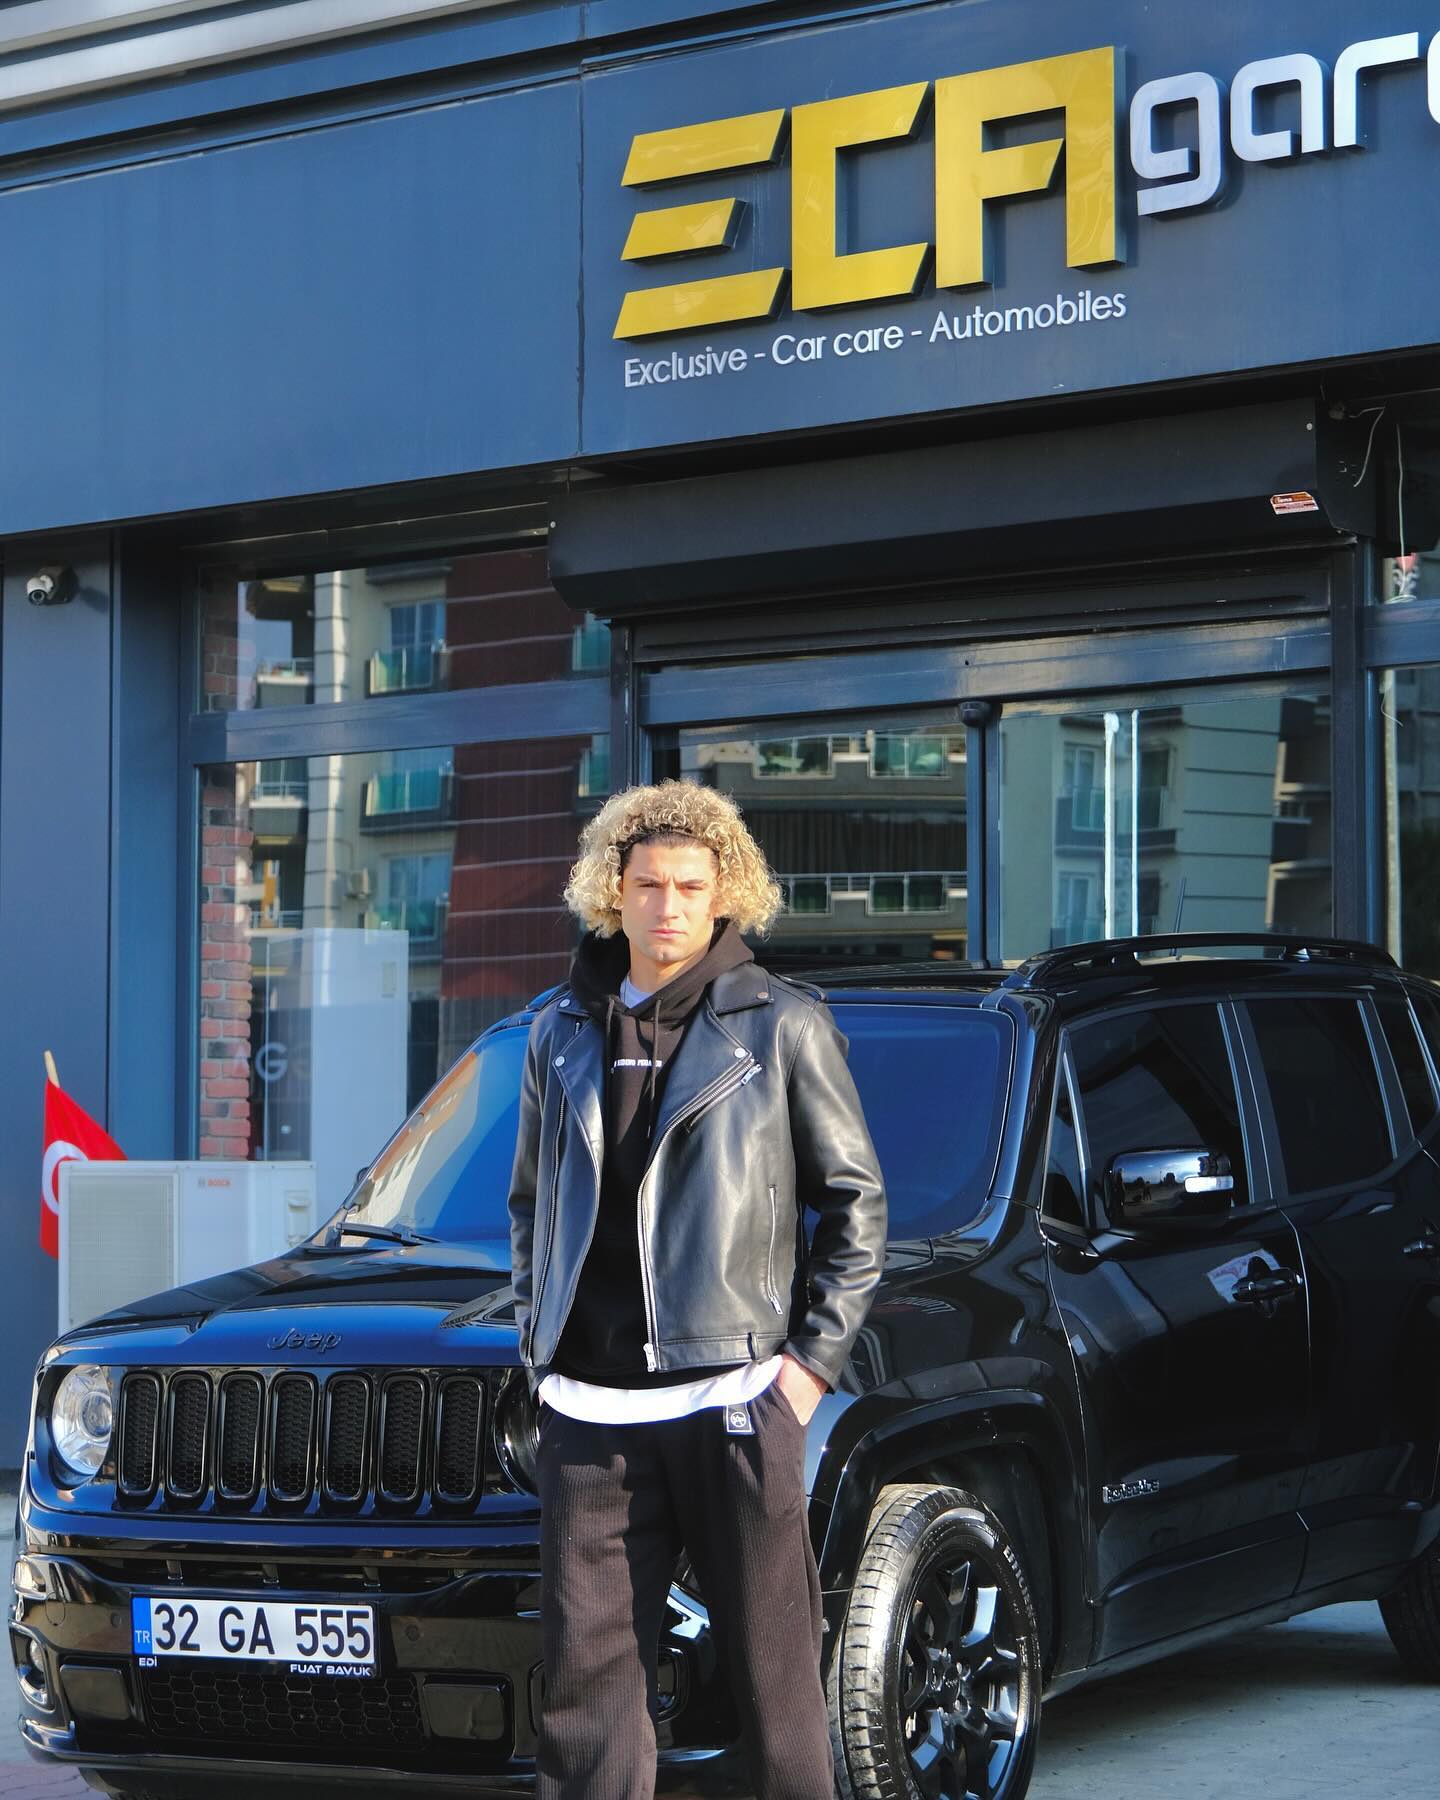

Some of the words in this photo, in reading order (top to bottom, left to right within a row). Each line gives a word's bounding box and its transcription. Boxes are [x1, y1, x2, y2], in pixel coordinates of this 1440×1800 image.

[1130, 30, 1440, 216] gar
[624, 345, 748, 388] Exclusive
[771, 334, 828, 365] Car
[832, 325, 905, 357] care
[928, 289, 1127, 343] Automobiles
[266, 1327, 342, 1353] Jeep
[134, 1630, 151, 1644] TR
[154, 1602, 201, 1652] 32
[218, 1605, 276, 1655] GA
[294, 1608, 372, 1660] 555
[289, 1663, 323, 1675] FUAT
[325, 1665, 372, 1677] BAVUK
